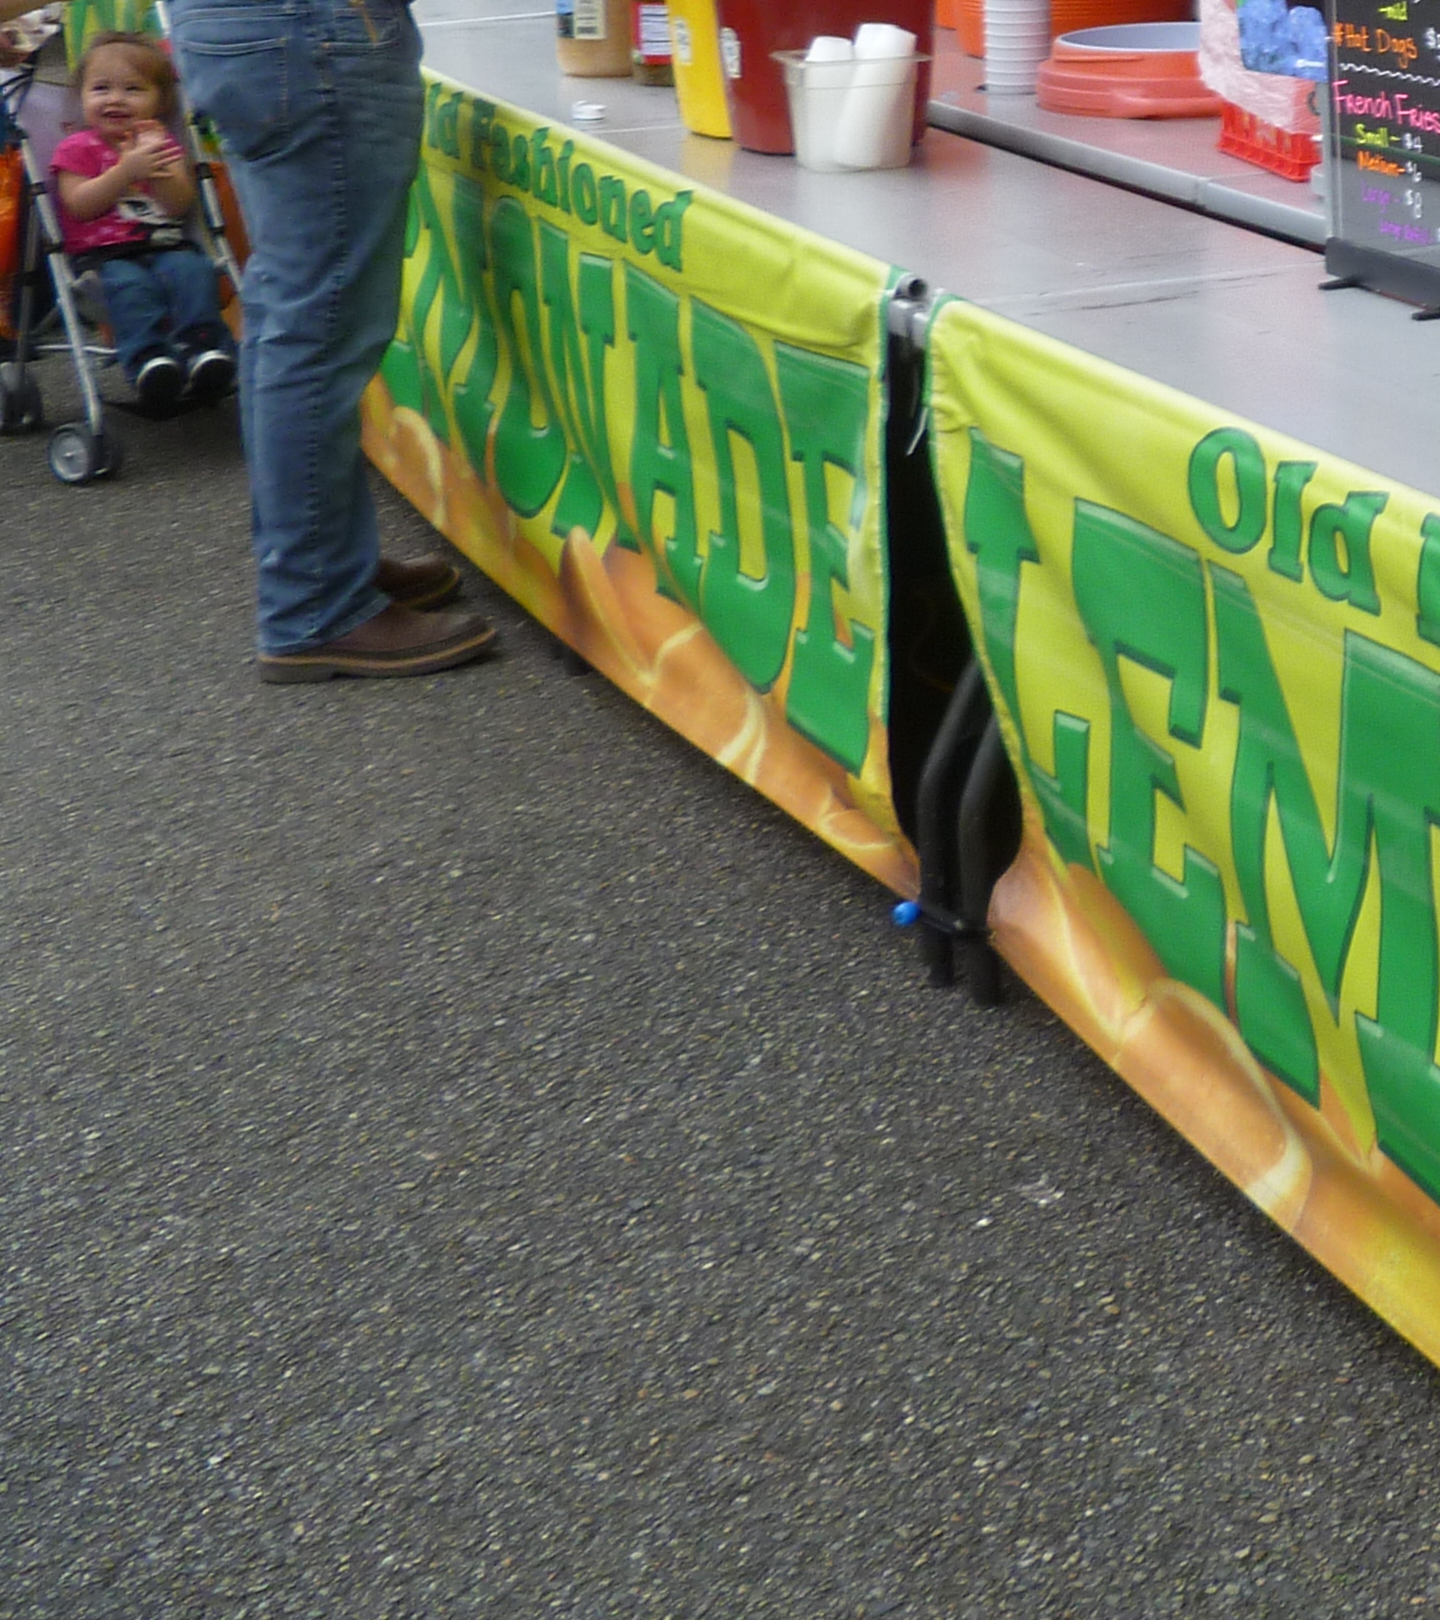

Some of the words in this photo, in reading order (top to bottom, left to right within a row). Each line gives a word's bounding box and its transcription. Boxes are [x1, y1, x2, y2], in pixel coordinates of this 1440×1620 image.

[1333, 80, 1392, 120] French
[1377, 28, 1418, 69] Dogs
[427, 82, 464, 160] ld
[470, 96, 693, 273] Fashioned
[1189, 426, 1389, 614] Old
